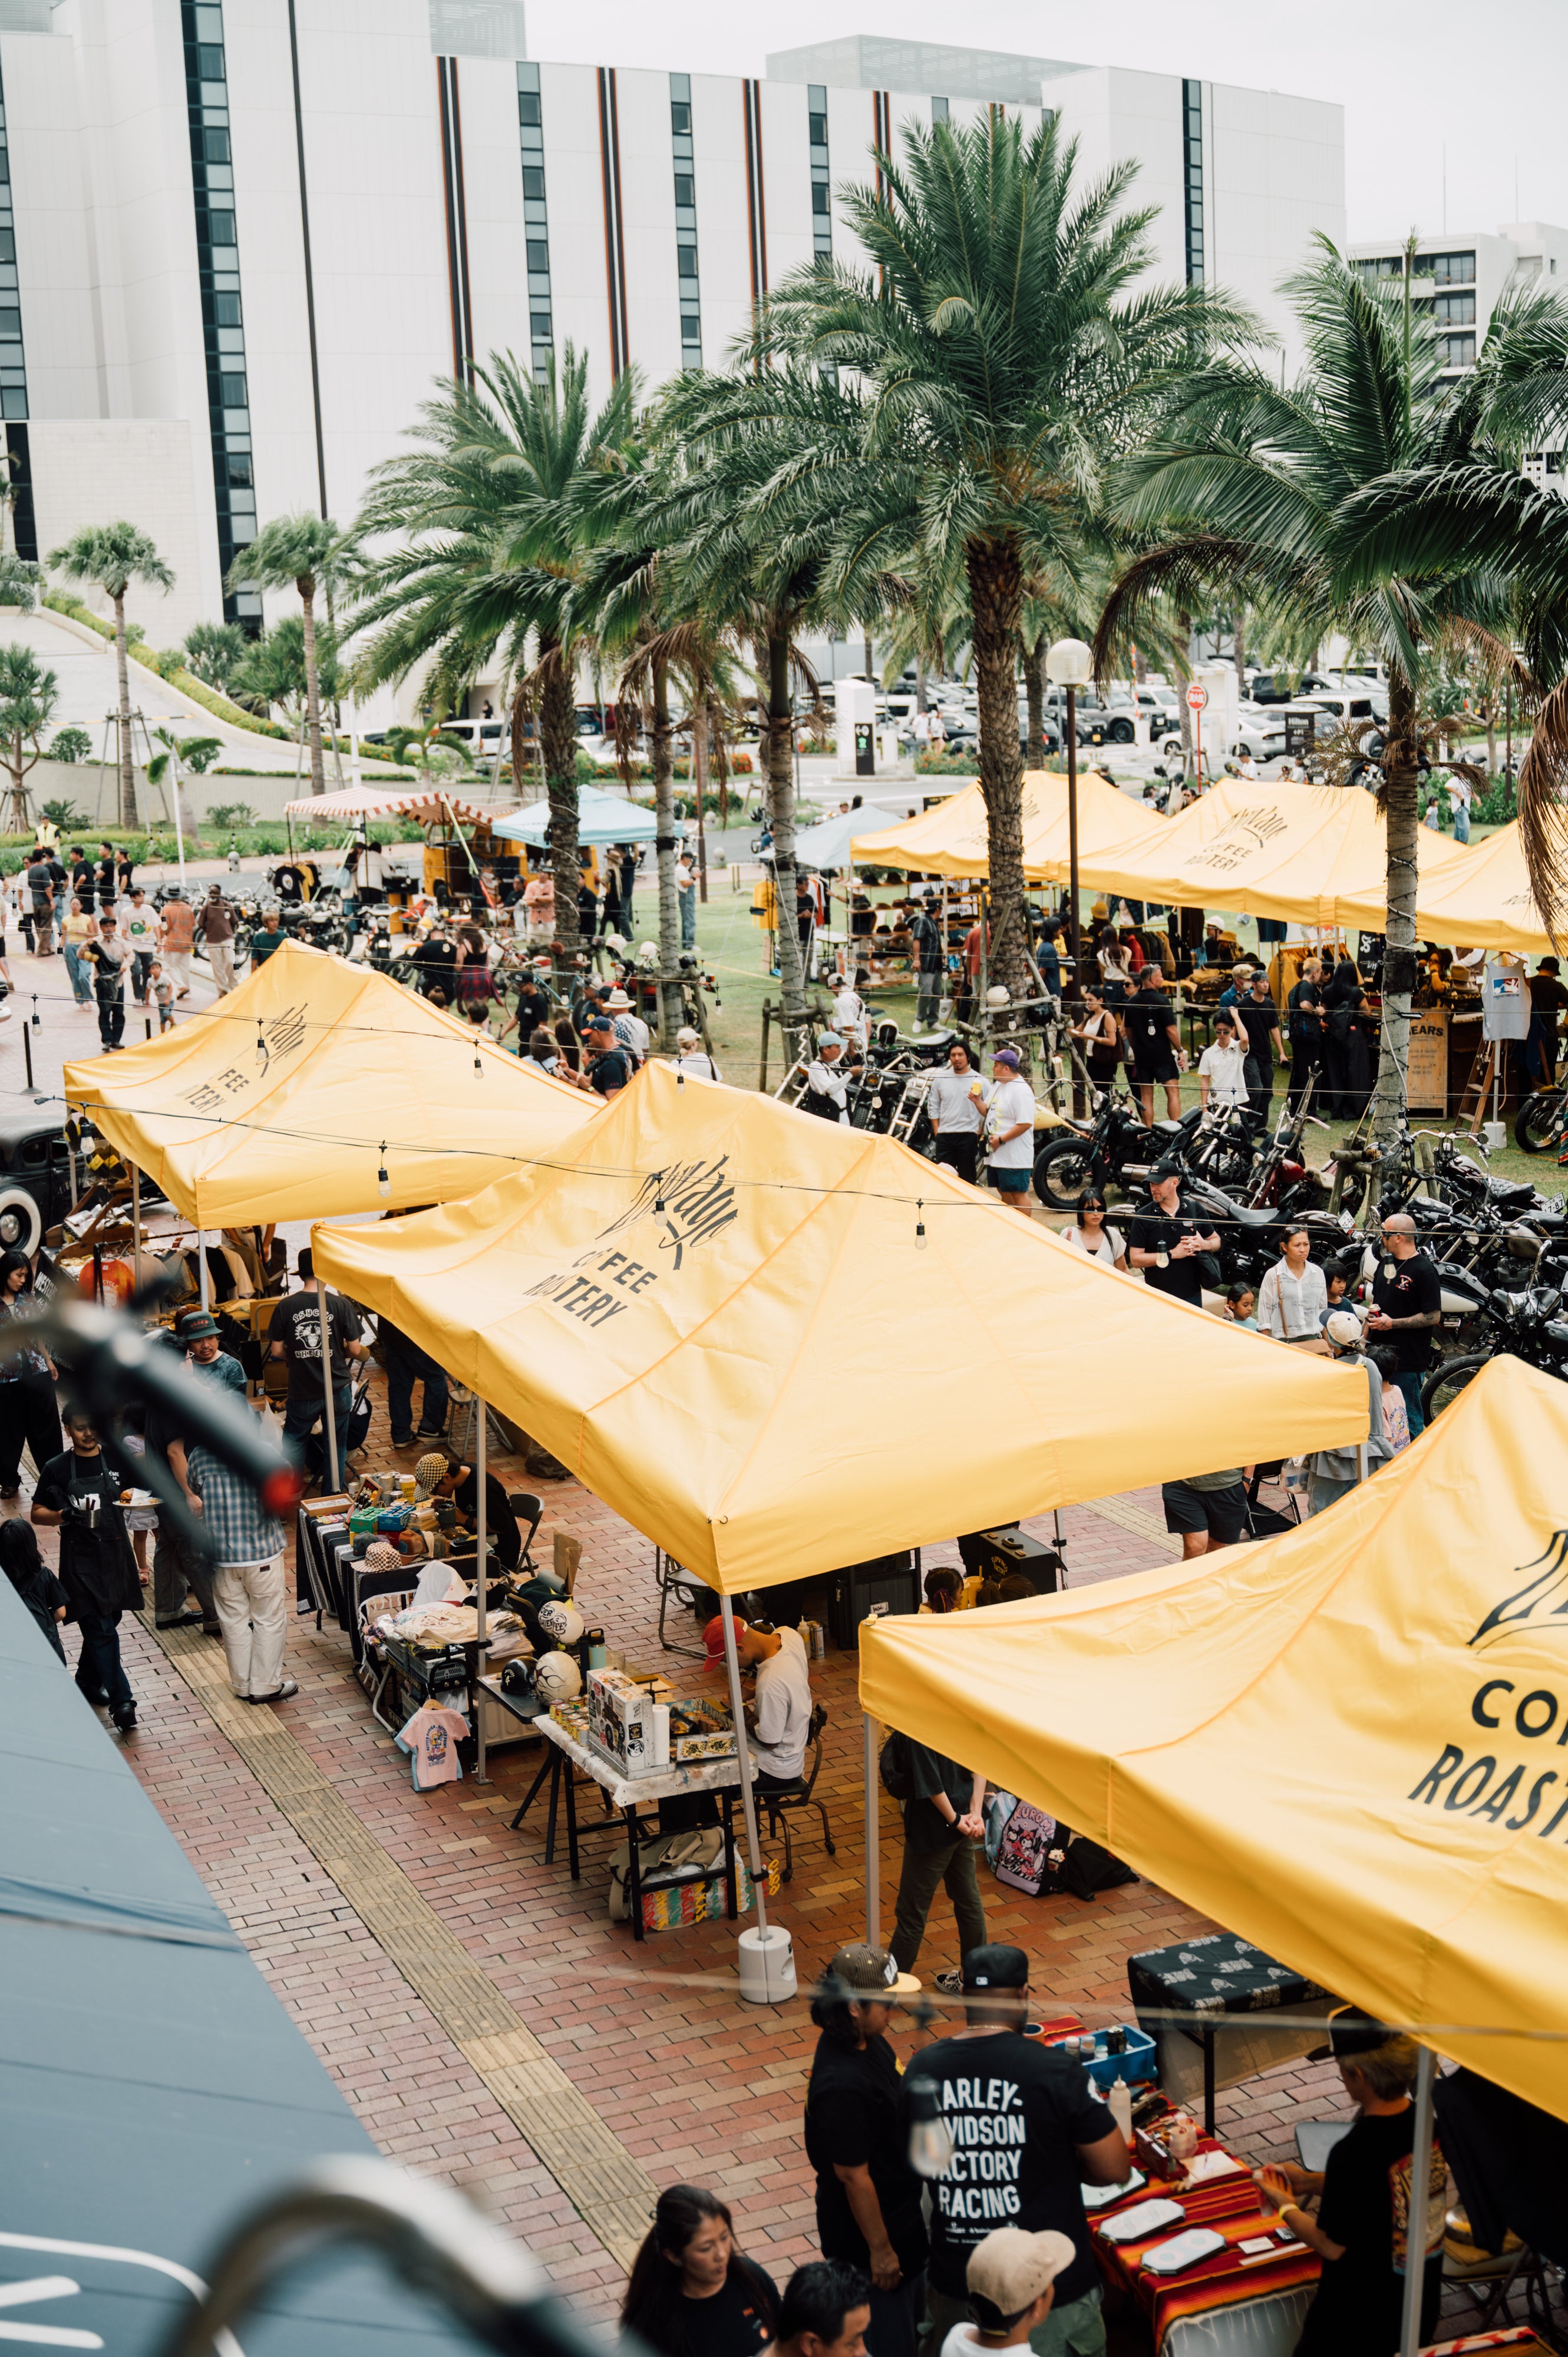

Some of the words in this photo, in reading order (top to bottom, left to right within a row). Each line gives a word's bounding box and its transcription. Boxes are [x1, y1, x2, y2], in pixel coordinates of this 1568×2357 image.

[1288, 717, 1309, 727] Hilton
[1409, 1025, 1444, 1036] EARS
[292, 1308, 334, 1323] PSYCO
[295, 1349, 334, 1358] WHEES
[1471, 1679, 1568, 1747] CO
[1408, 1743, 1568, 1844] ROAST
[1013, 1806, 1055, 1836] KUROMI
[936, 2077, 1023, 2112] ARLEY-
[940, 2114, 1026, 2145] VIDSON
[933, 2149, 1022, 2181] ACTORY
[938, 2184, 1021, 2219] RACING
